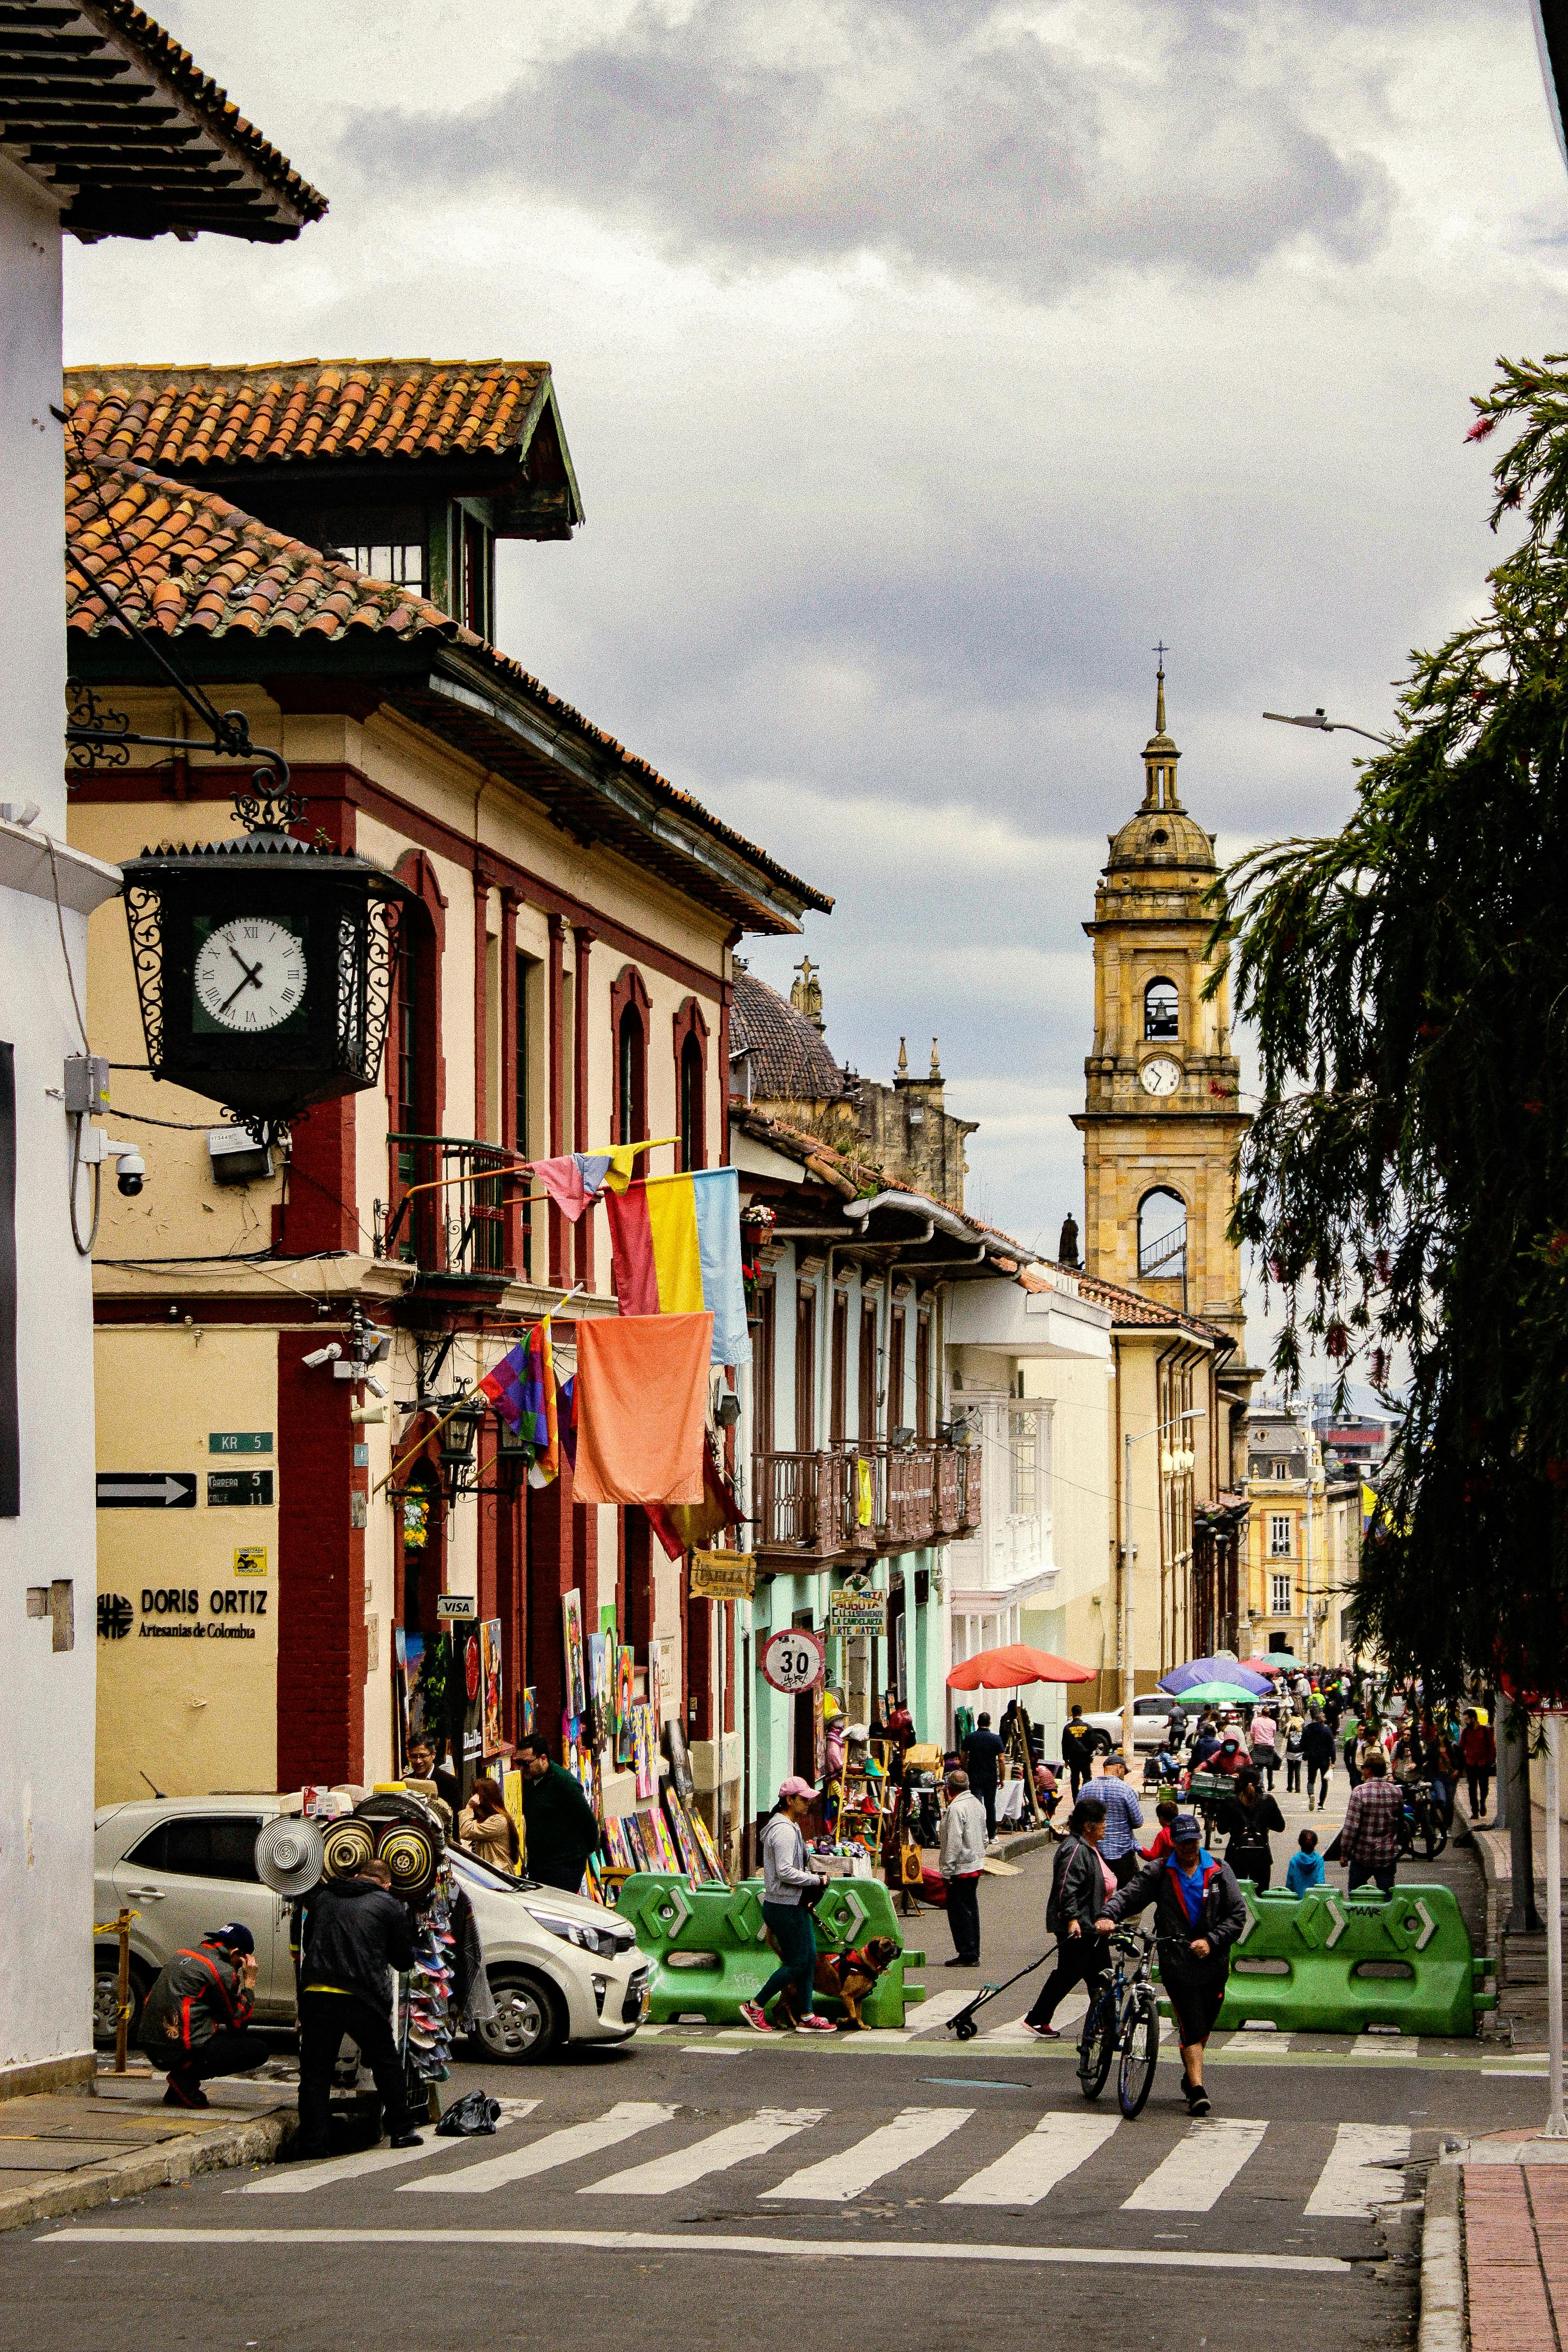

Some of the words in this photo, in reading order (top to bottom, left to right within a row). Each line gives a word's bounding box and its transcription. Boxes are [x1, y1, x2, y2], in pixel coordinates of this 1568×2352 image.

[222, 931, 236, 943] XI
[243, 927, 258, 938] XII
[269, 932, 276, 942] I
[208, 948, 221, 959] X
[282, 948, 294, 958] II
[203, 969, 214, 980] IX
[288, 970, 299, 979] III
[206, 987, 222, 1006] VIII
[281, 987, 295, 1002] IIII
[246, 1011, 256, 1022] VI
[269, 1006, 278, 1017] V
[222, 1436, 237, 1449] KR
[254, 1436, 261, 1449] 5
[208, 1476, 238, 1489] CARRERA
[252, 1472, 260, 1486] 5
[250, 1493, 262, 1505] 11
[142, 1589, 199, 1613] DORIS
[210, 1590, 267, 1613] ORTIZ
[443, 1602, 470, 1612] VISA
[193, 1622, 205, 1637] de
[207, 1622, 256, 1638] Colombia
[832, 1626, 852, 1635] ARTE
[780, 1651, 809, 1674] 30
